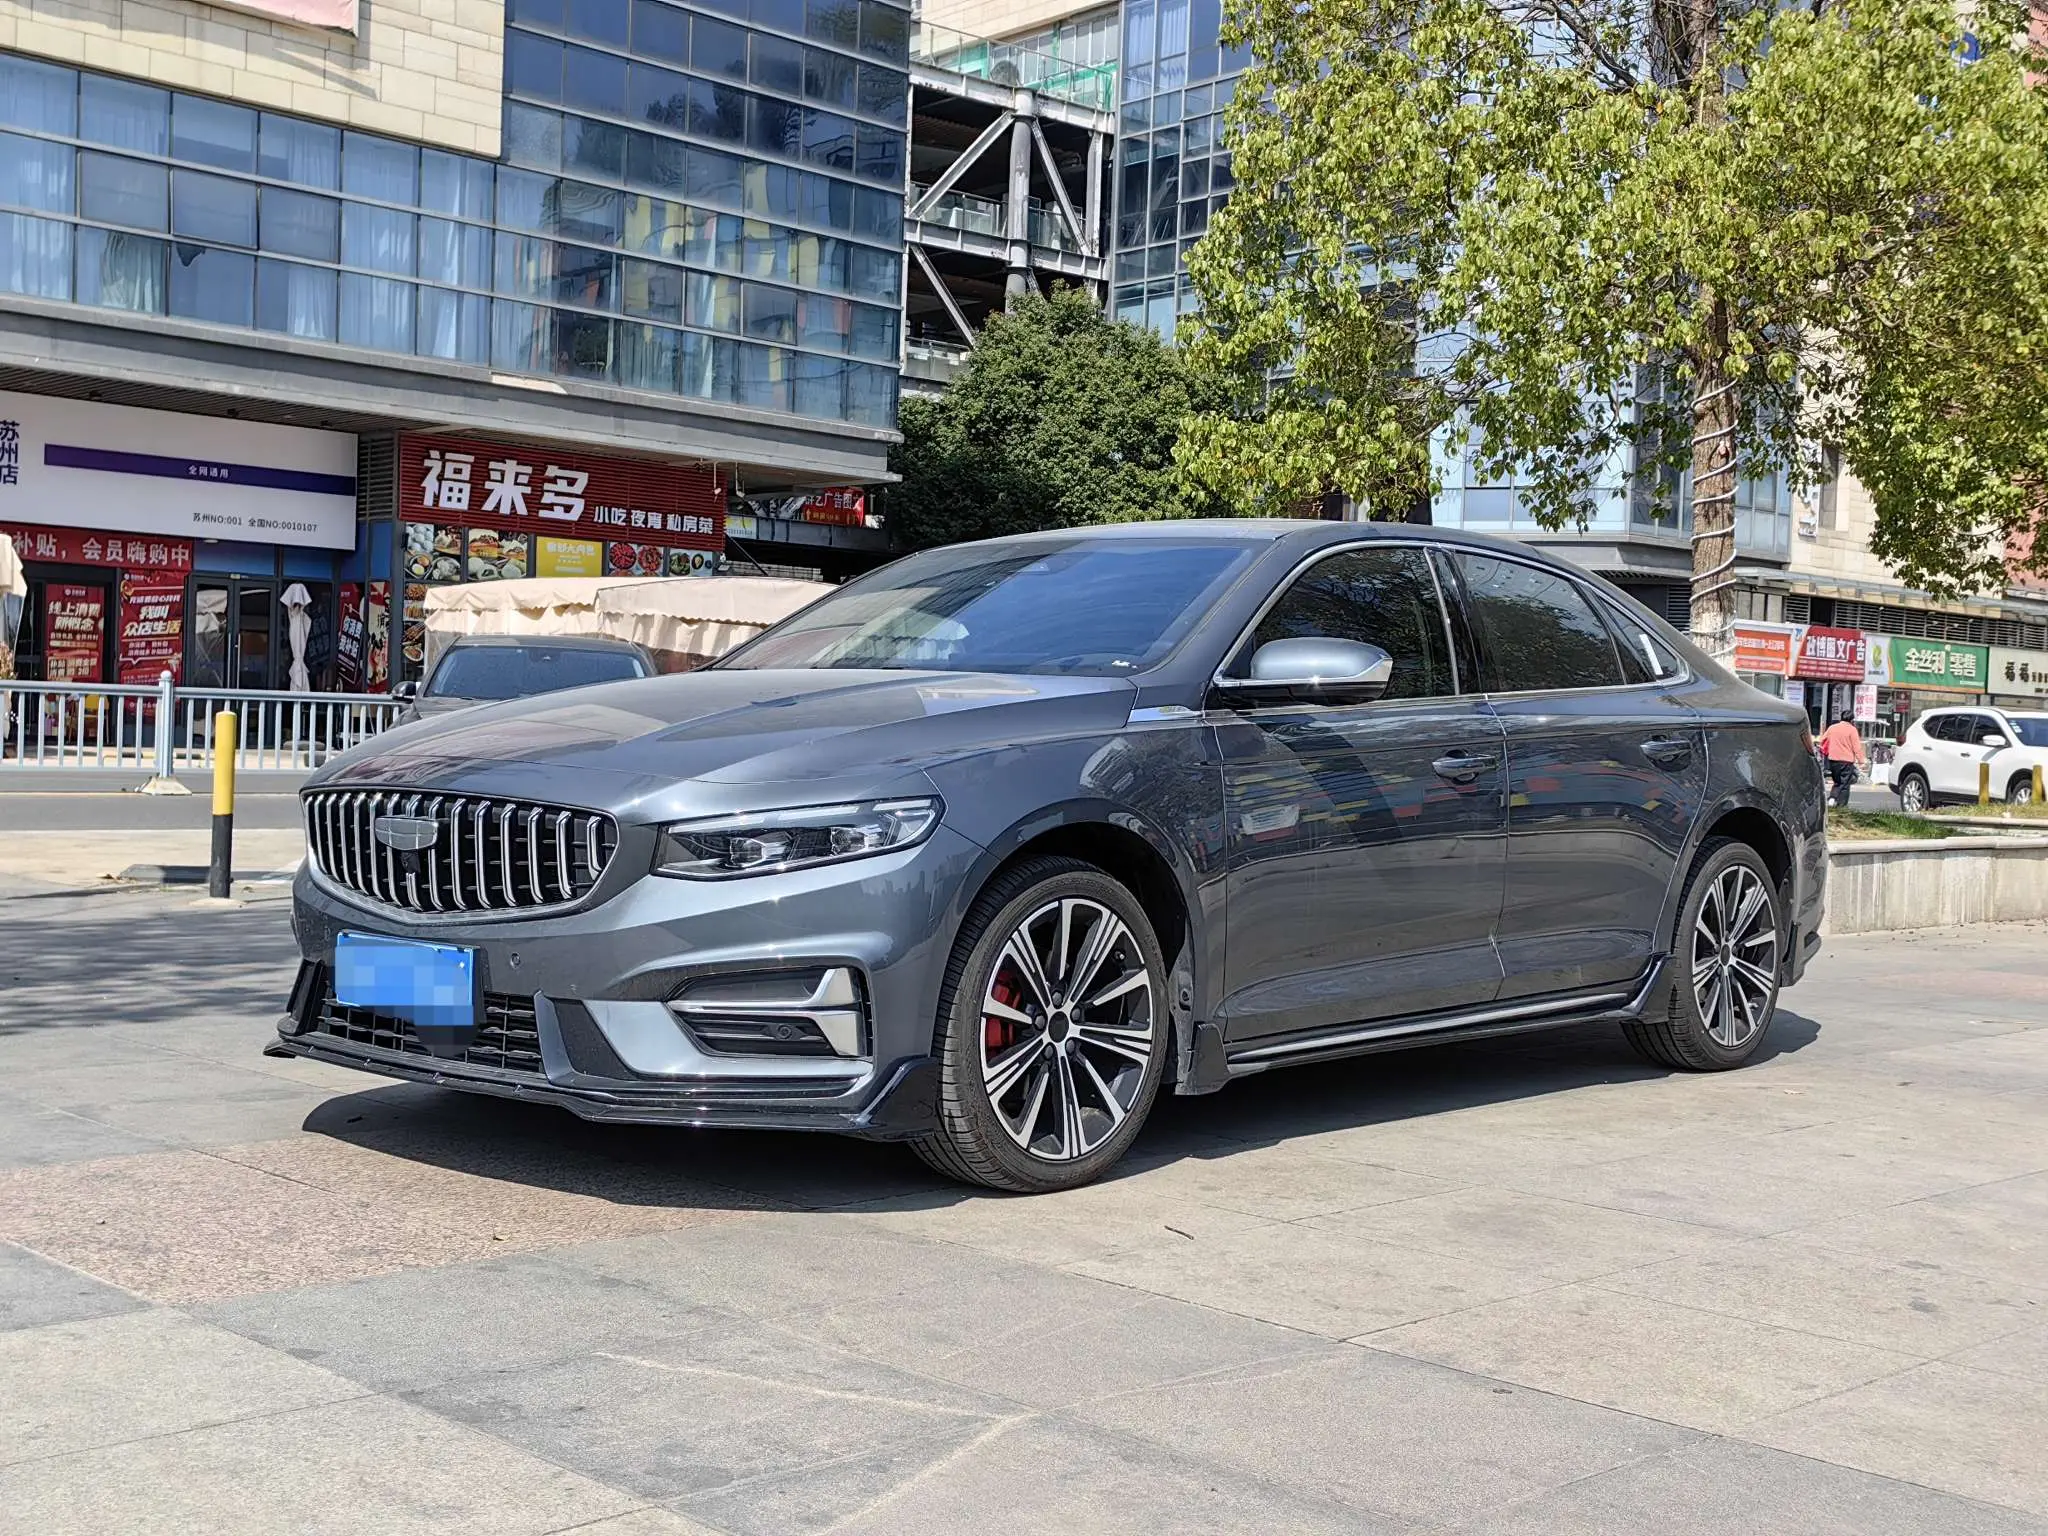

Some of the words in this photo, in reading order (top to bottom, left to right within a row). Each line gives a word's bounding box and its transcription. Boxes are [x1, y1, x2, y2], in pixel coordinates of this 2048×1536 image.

[0, 420, 20, 485] 苏州店
[421, 450, 588, 521] 福来多
[593, 506, 628, 526] 小吃
[630, 509, 662, 530] 夜宵
[666, 514, 713, 535] 私房菜
[122, 619, 182, 637] 众店生活
[1904, 648, 1946, 675] 金丝利
[1949, 652, 1977, 678] 零售
